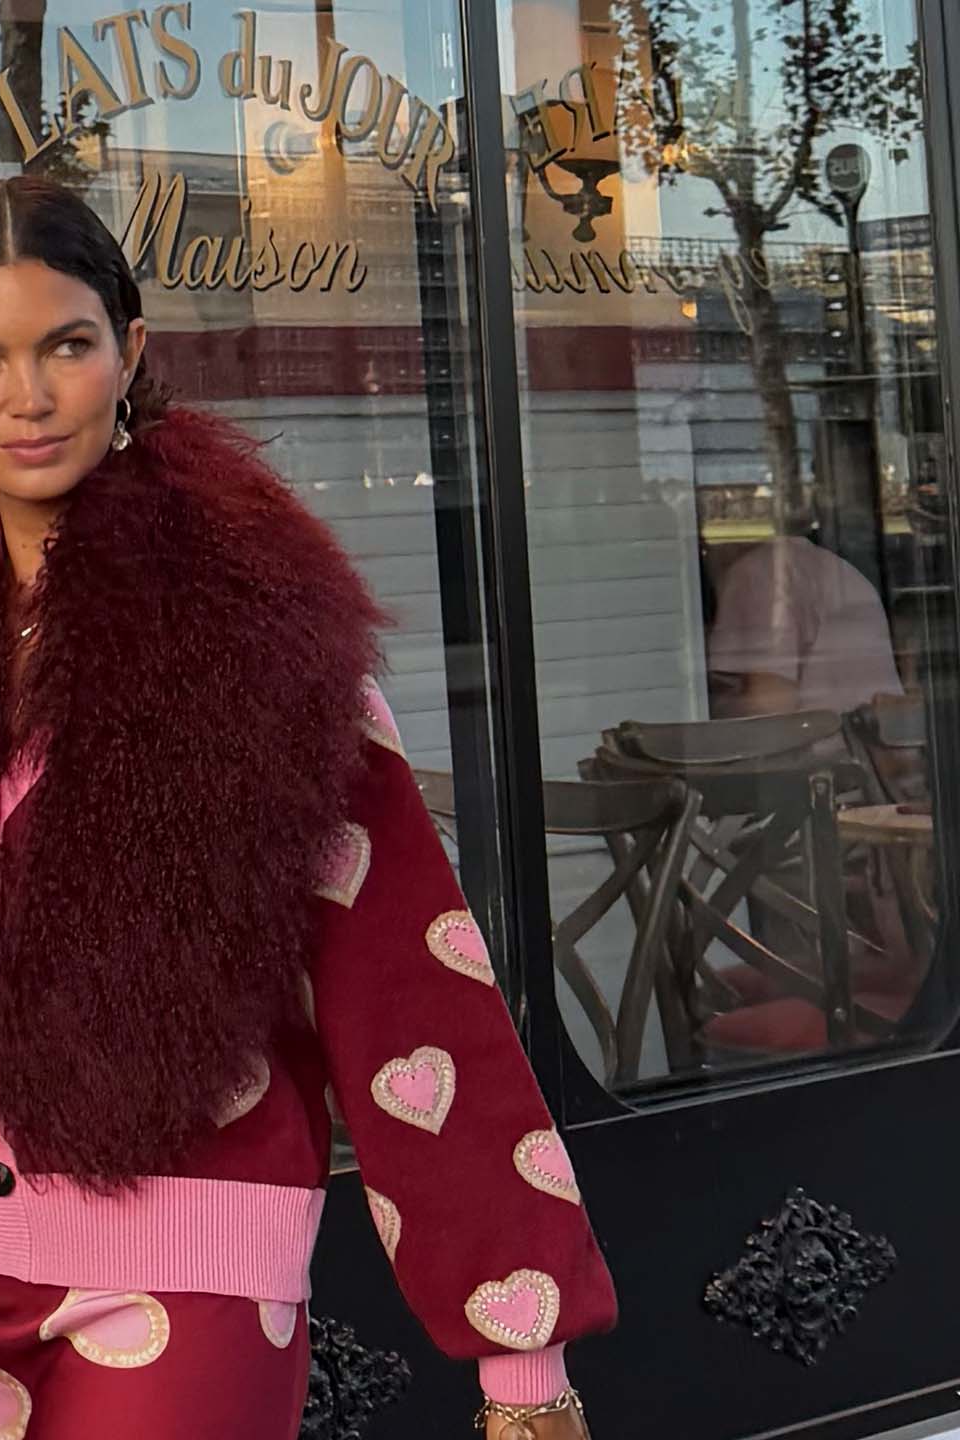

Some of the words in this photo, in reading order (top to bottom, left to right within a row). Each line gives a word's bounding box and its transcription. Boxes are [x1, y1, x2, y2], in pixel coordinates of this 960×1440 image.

[221, 9, 292, 111] du
[298, 36, 456, 213] JOUR
[120, 168, 368, 292] Maison
